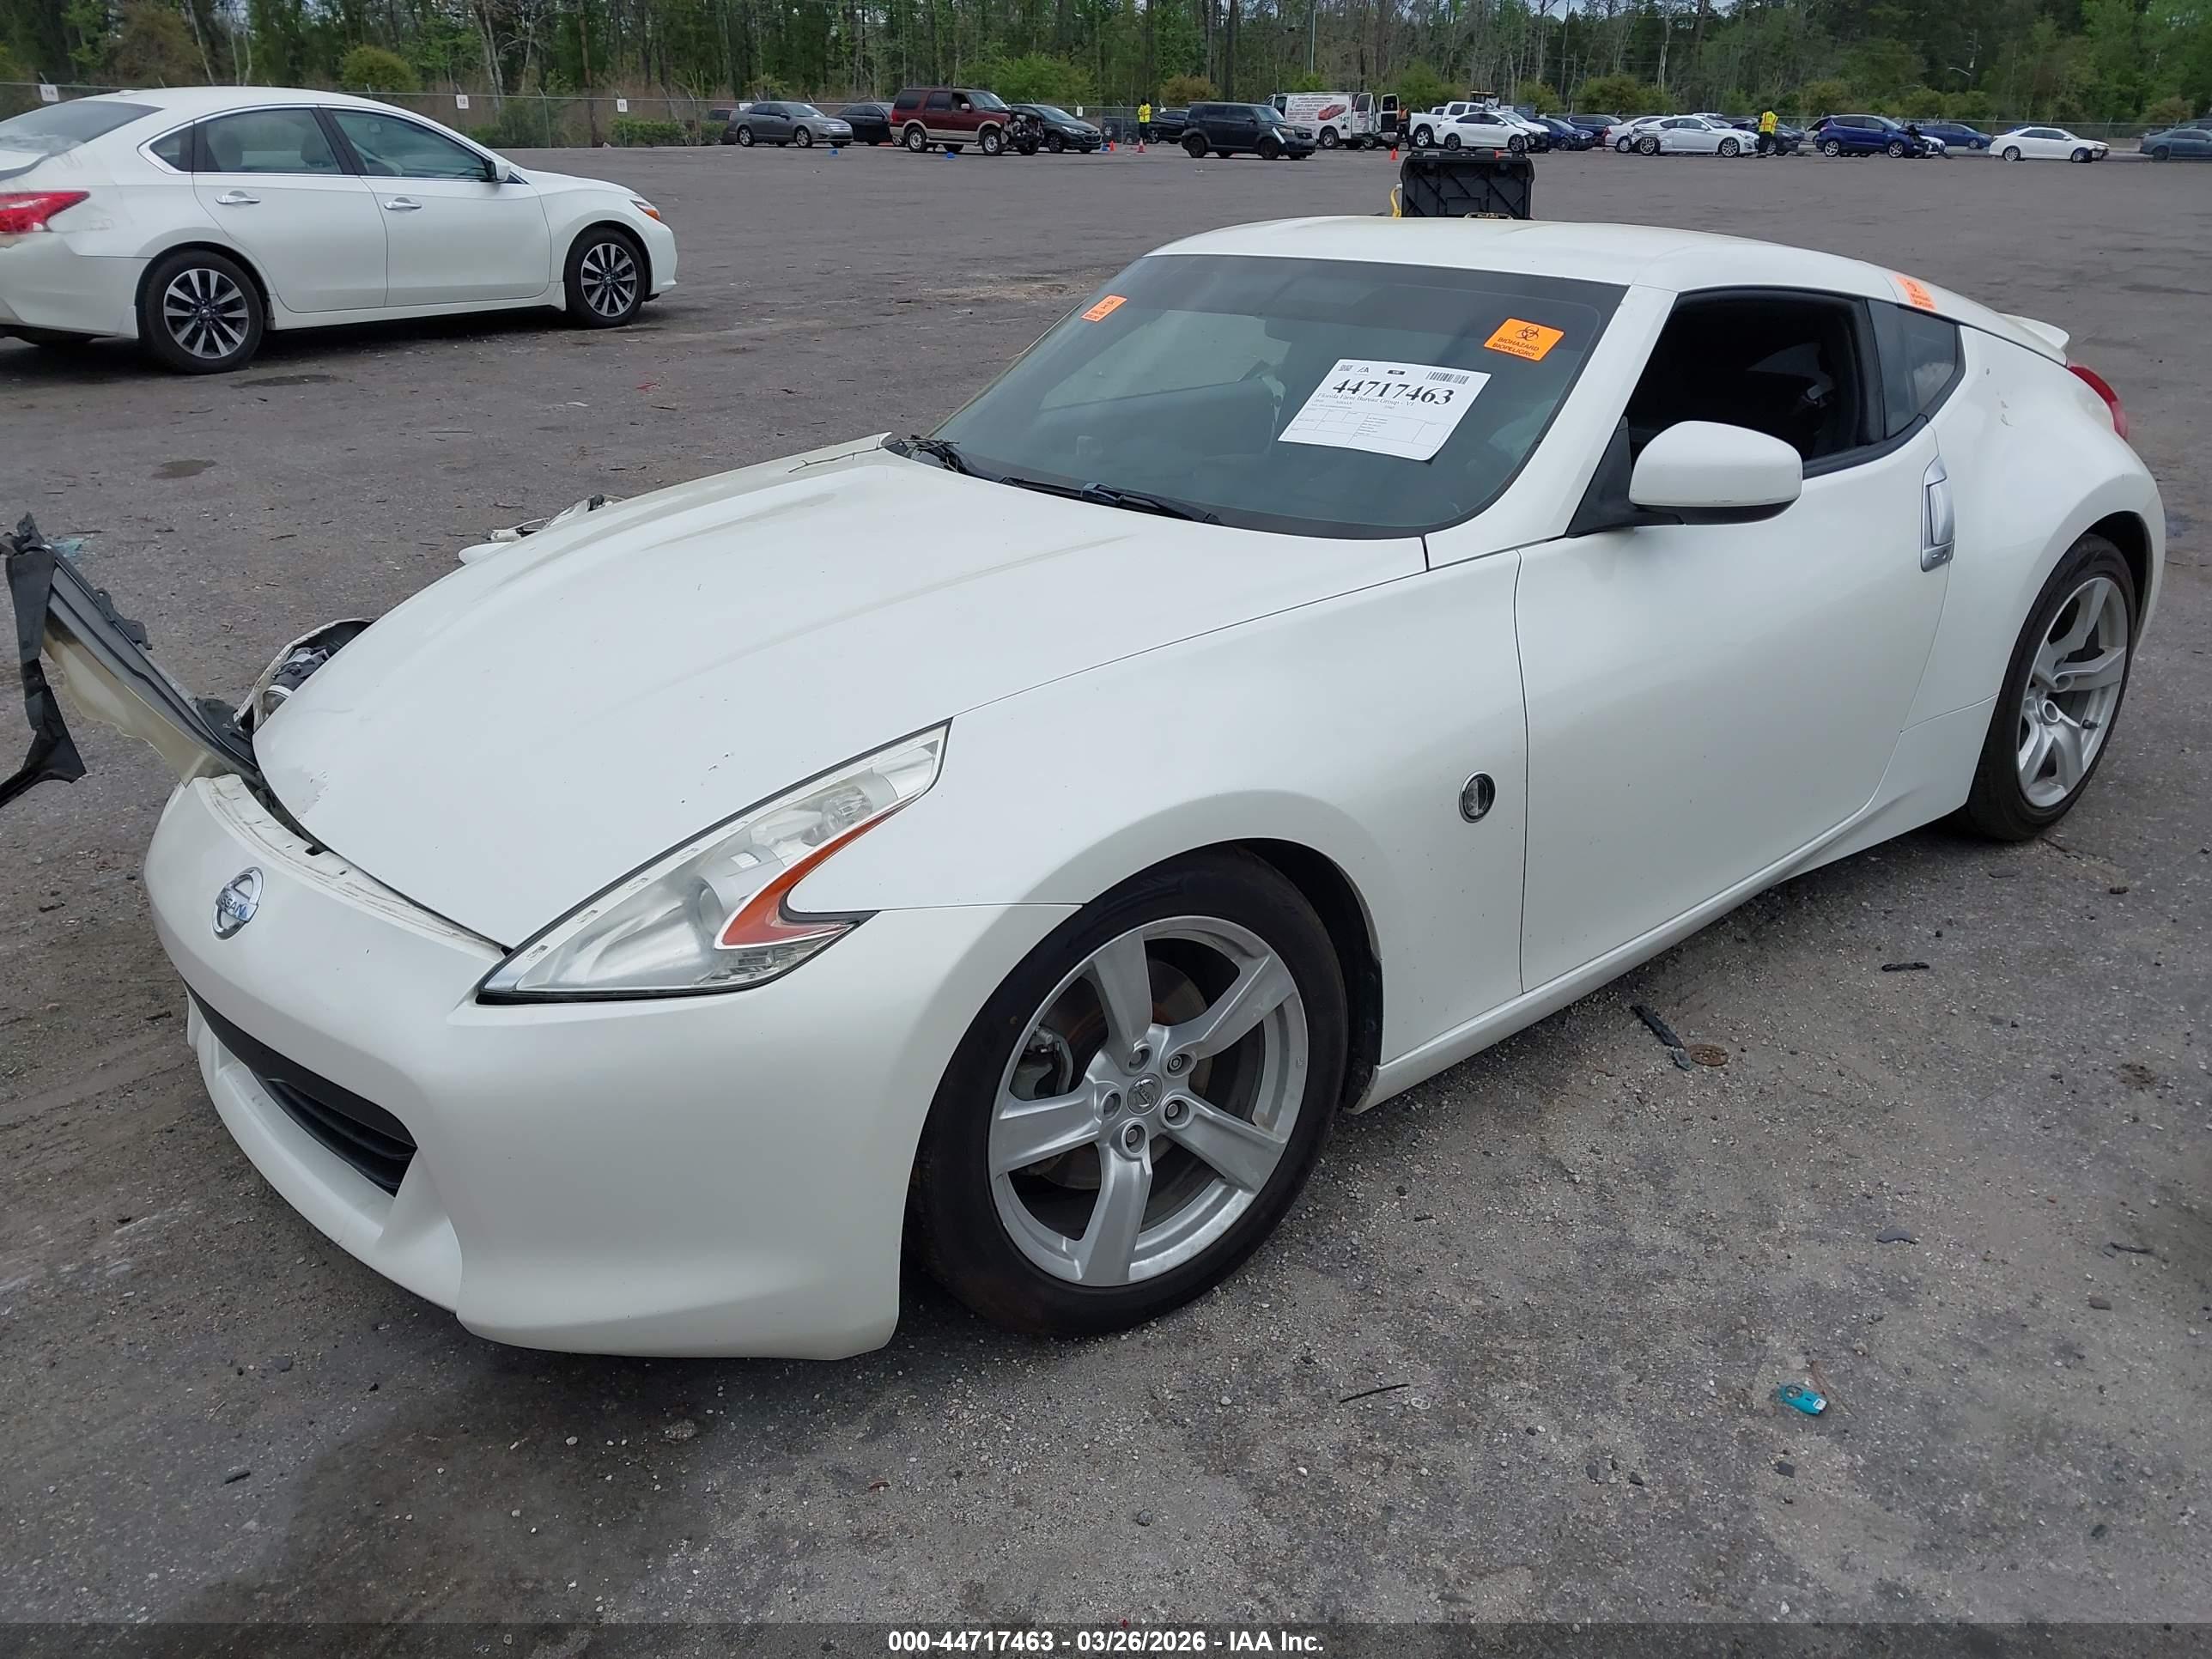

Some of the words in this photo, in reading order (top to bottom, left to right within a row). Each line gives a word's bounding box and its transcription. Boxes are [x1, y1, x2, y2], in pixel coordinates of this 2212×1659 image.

[1492, 343, 1535, 357] BIOPELIGRO
[1497, 337, 1540, 351] BIOHAZARD
[1332, 378, 1455, 405] 44717463
